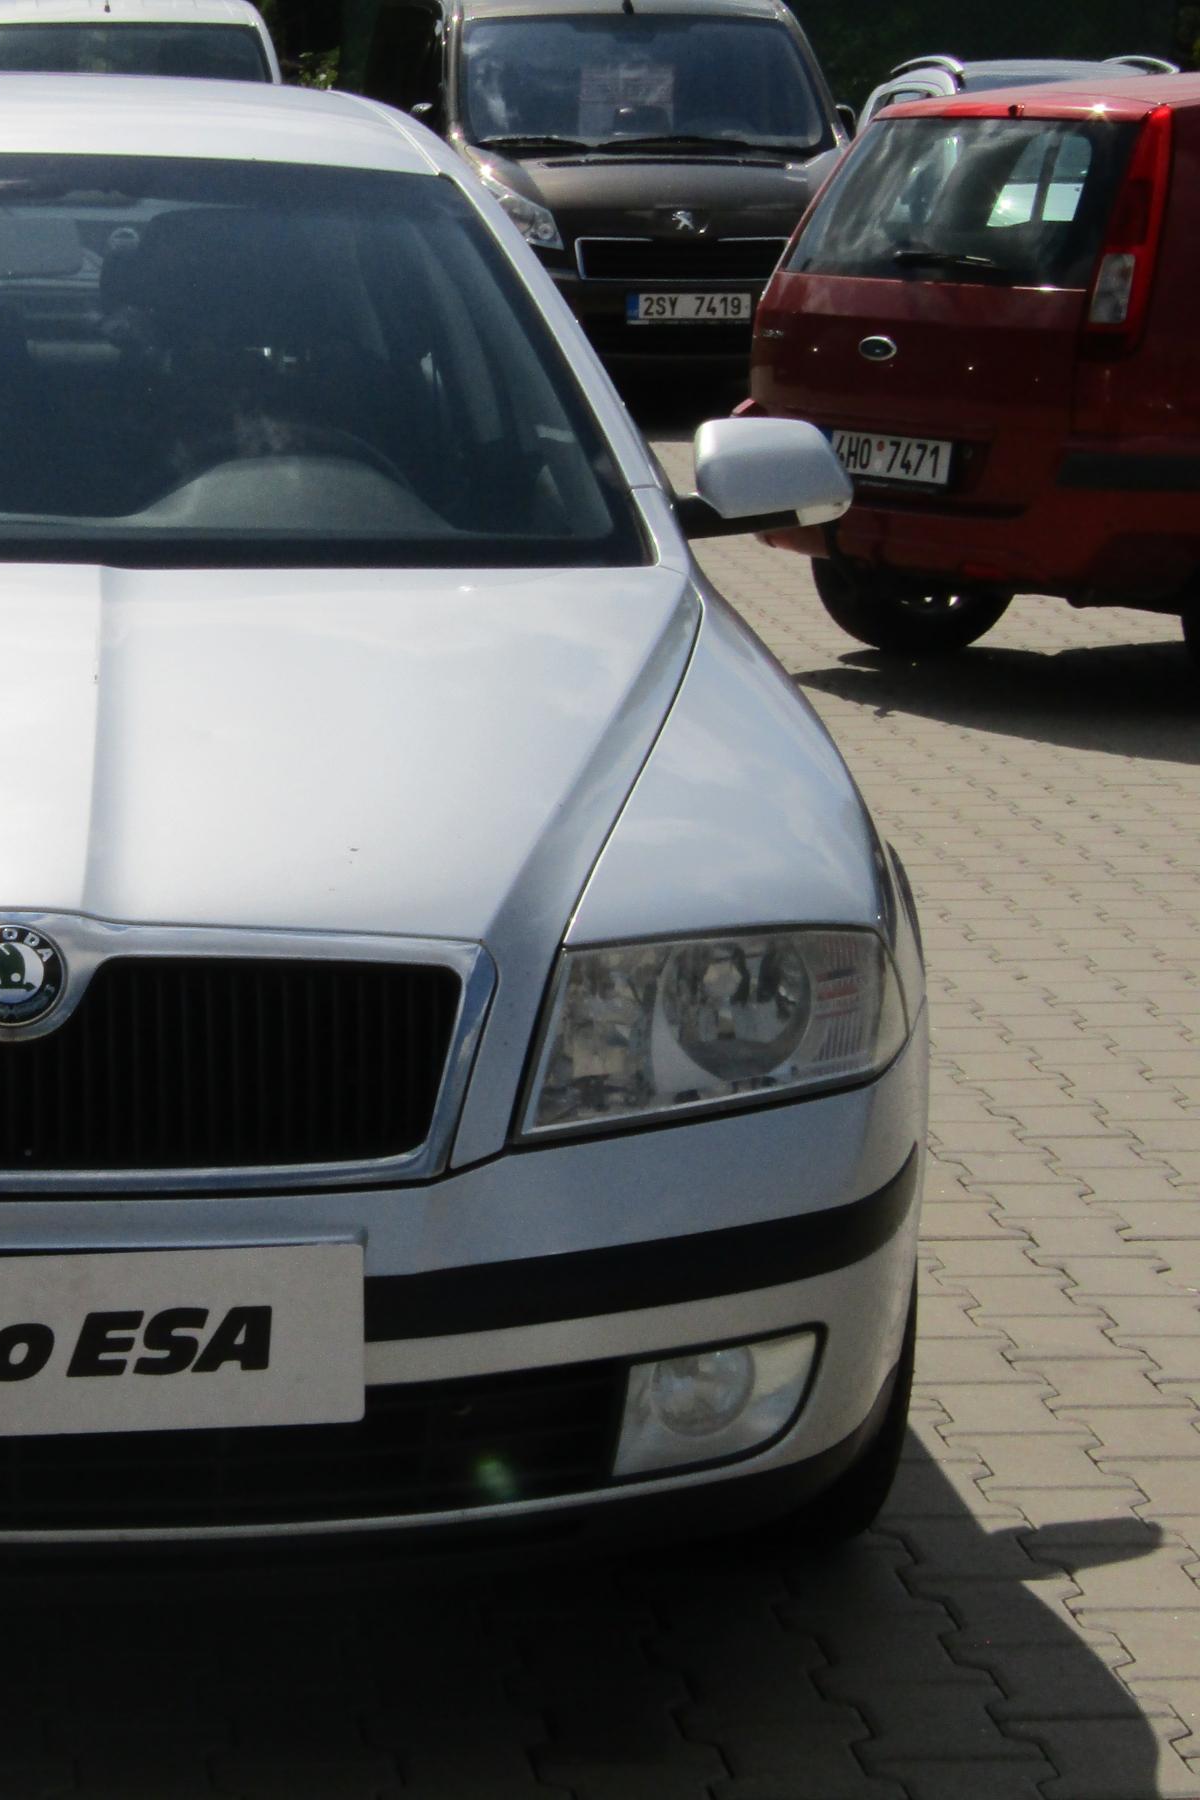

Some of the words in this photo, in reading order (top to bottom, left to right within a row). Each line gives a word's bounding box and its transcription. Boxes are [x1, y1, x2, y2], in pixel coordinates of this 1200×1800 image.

[643, 296, 679, 316] 2SY
[694, 296, 742, 316] 7419
[886, 440, 940, 479] 7471
[66, 1306, 273, 1378] ESA
